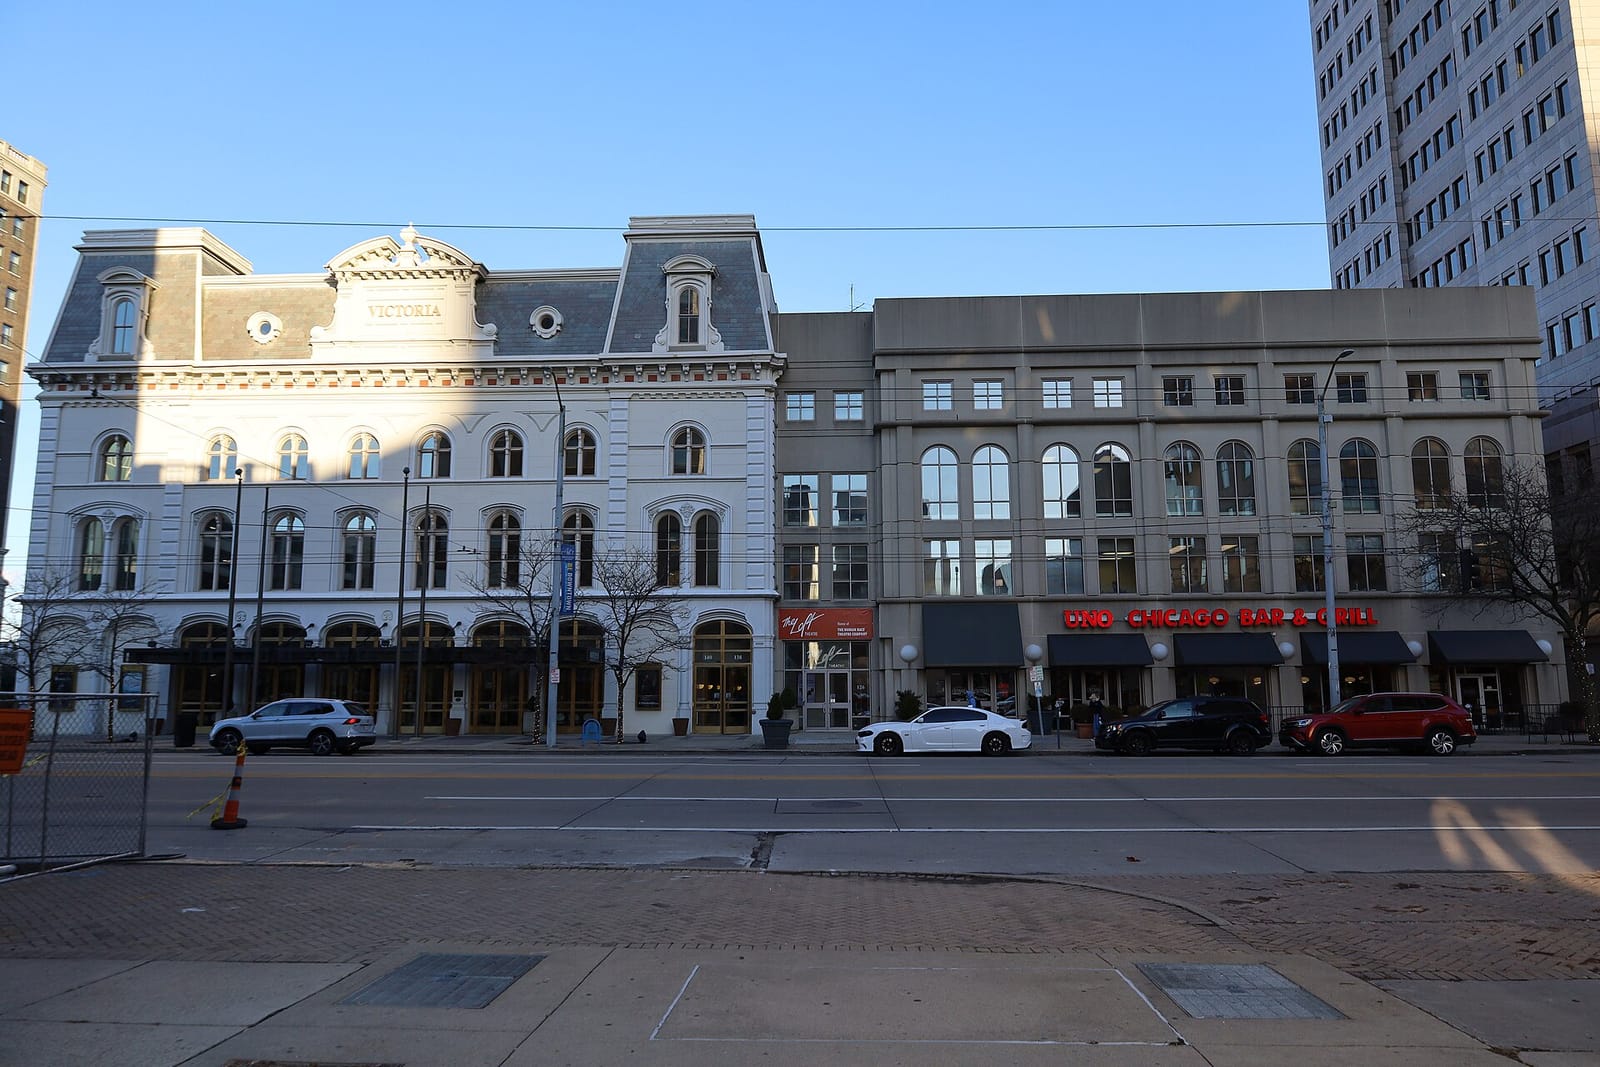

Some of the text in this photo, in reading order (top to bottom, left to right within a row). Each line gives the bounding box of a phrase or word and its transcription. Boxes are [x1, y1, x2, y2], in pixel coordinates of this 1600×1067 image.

[367, 304, 441, 318] VICTORIA
[565, 572, 574, 611] DOWNTOWN
[790, 612, 825, 639] Loft
[1063, 607, 1379, 629] UNO CHICAGO BAR & GRILL
